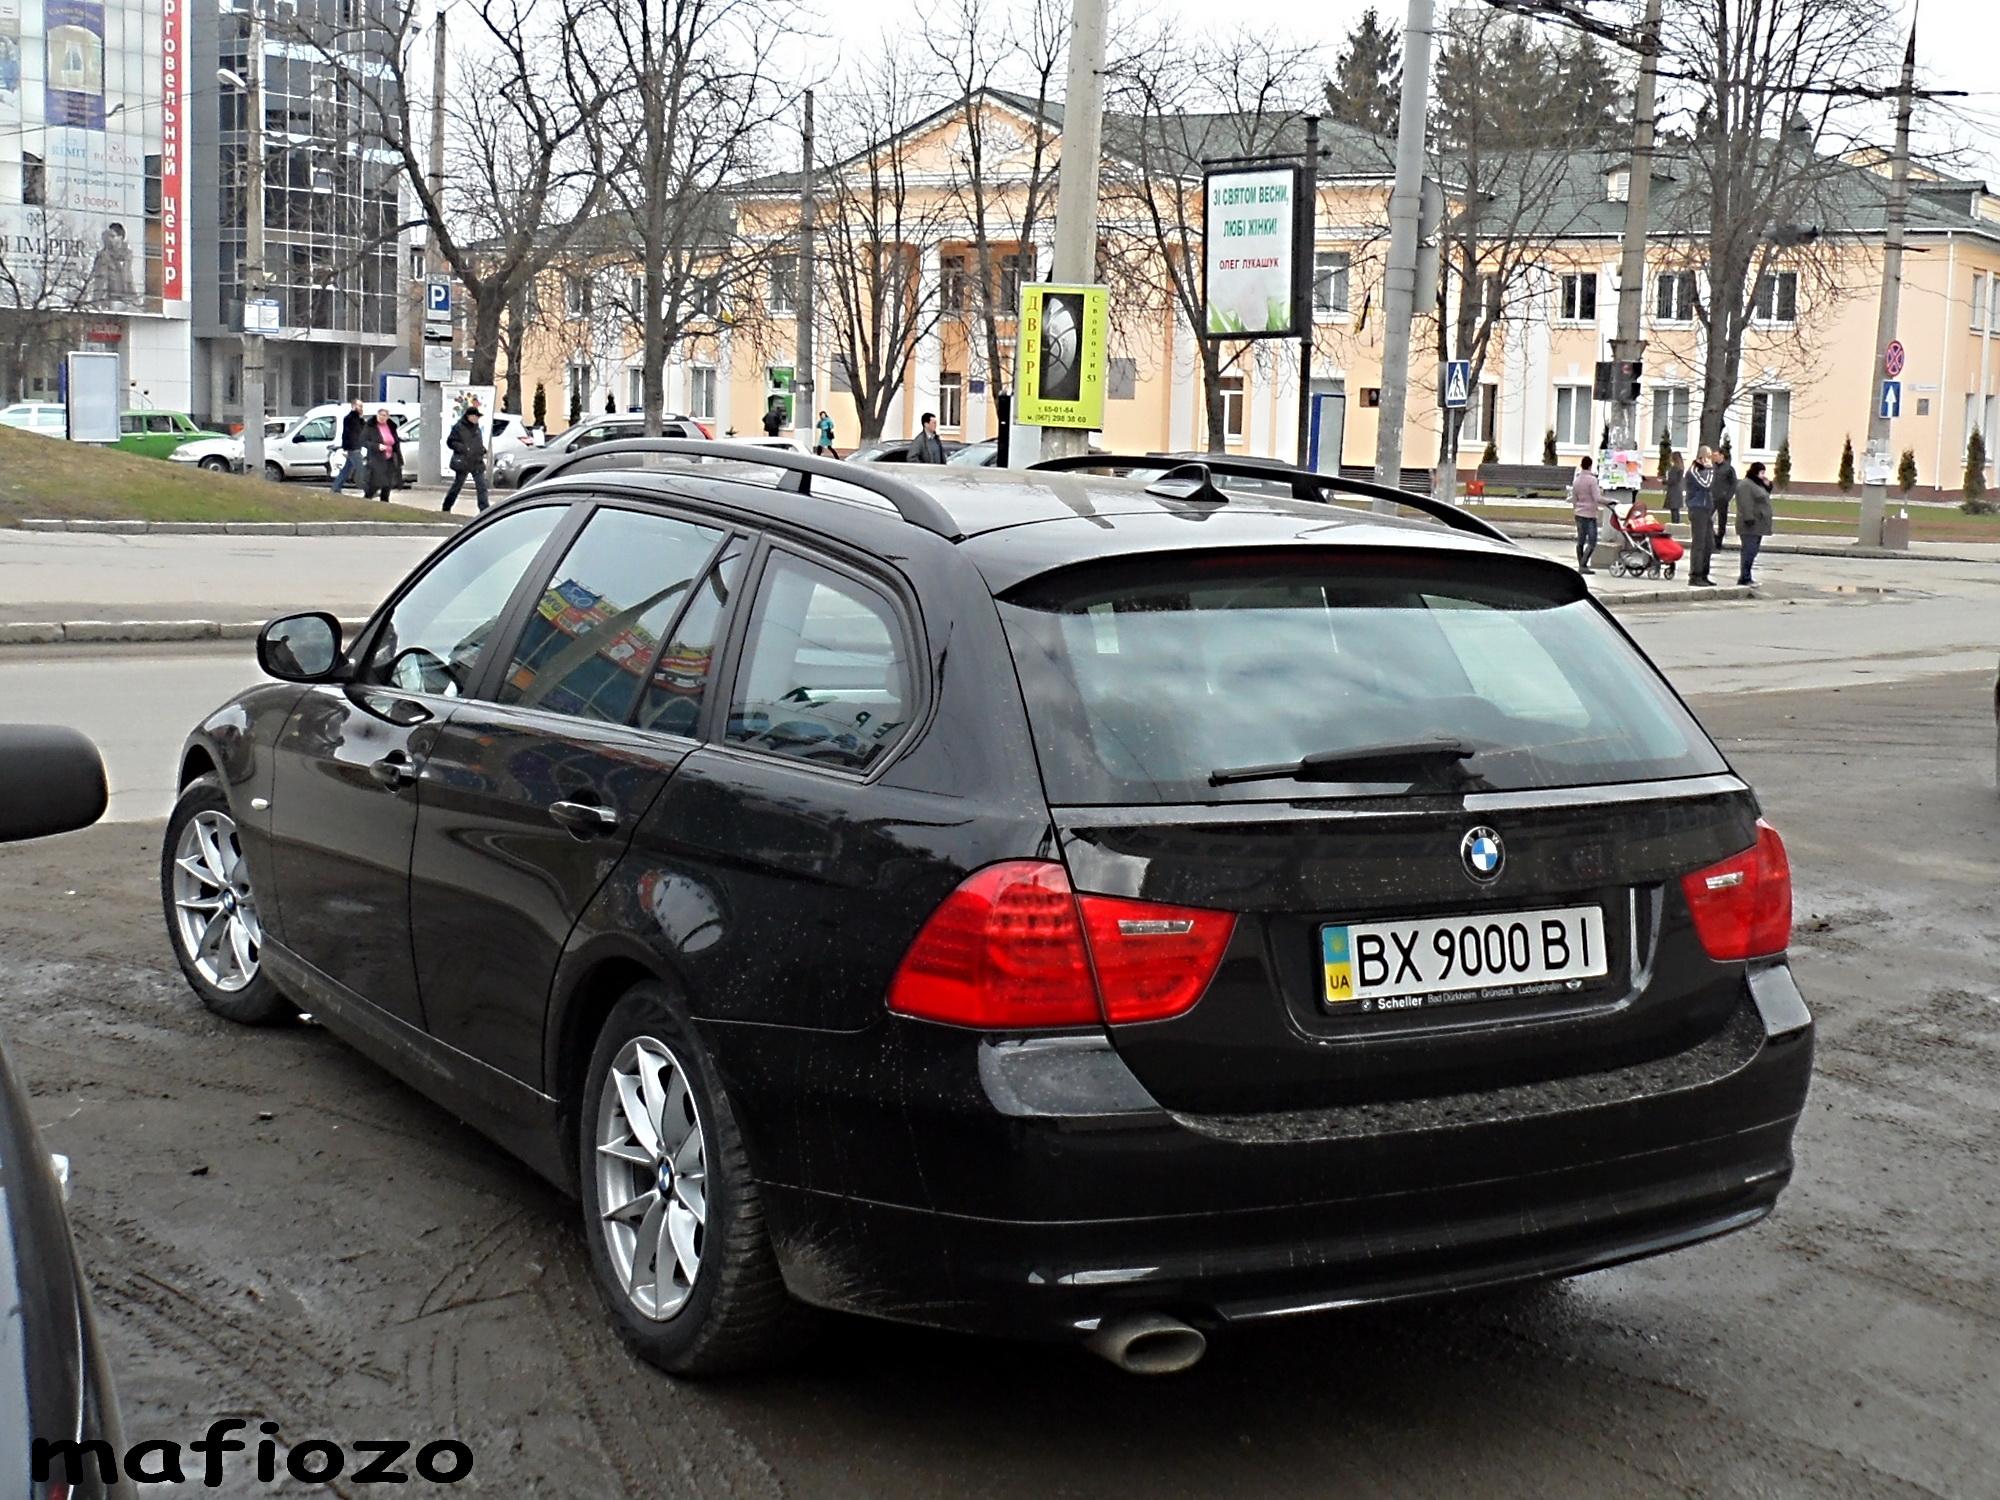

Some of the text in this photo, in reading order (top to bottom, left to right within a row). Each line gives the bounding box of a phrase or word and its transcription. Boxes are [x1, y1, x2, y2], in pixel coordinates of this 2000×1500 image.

[1213, 184, 1289, 206] ЗІ СВЯТОМ ВЕСНИ,
[1223, 218, 1278, 237] ЛЮБІ ЖІНКИ!
[164, 197, 177, 284] центр
[1219, 257, 1280, 270] ОЛЕГ ЛУКАШУК
[430, 285, 446, 309] P
[1027, 296, 1039, 396] ДВЕРІ
[1356, 917, 1590, 987] BX 9000 BI
[1330, 974, 1350, 990] UA
[1378, 996, 1423, 1010] Scheller
[1427, 994, 1442, 1004] Bad
